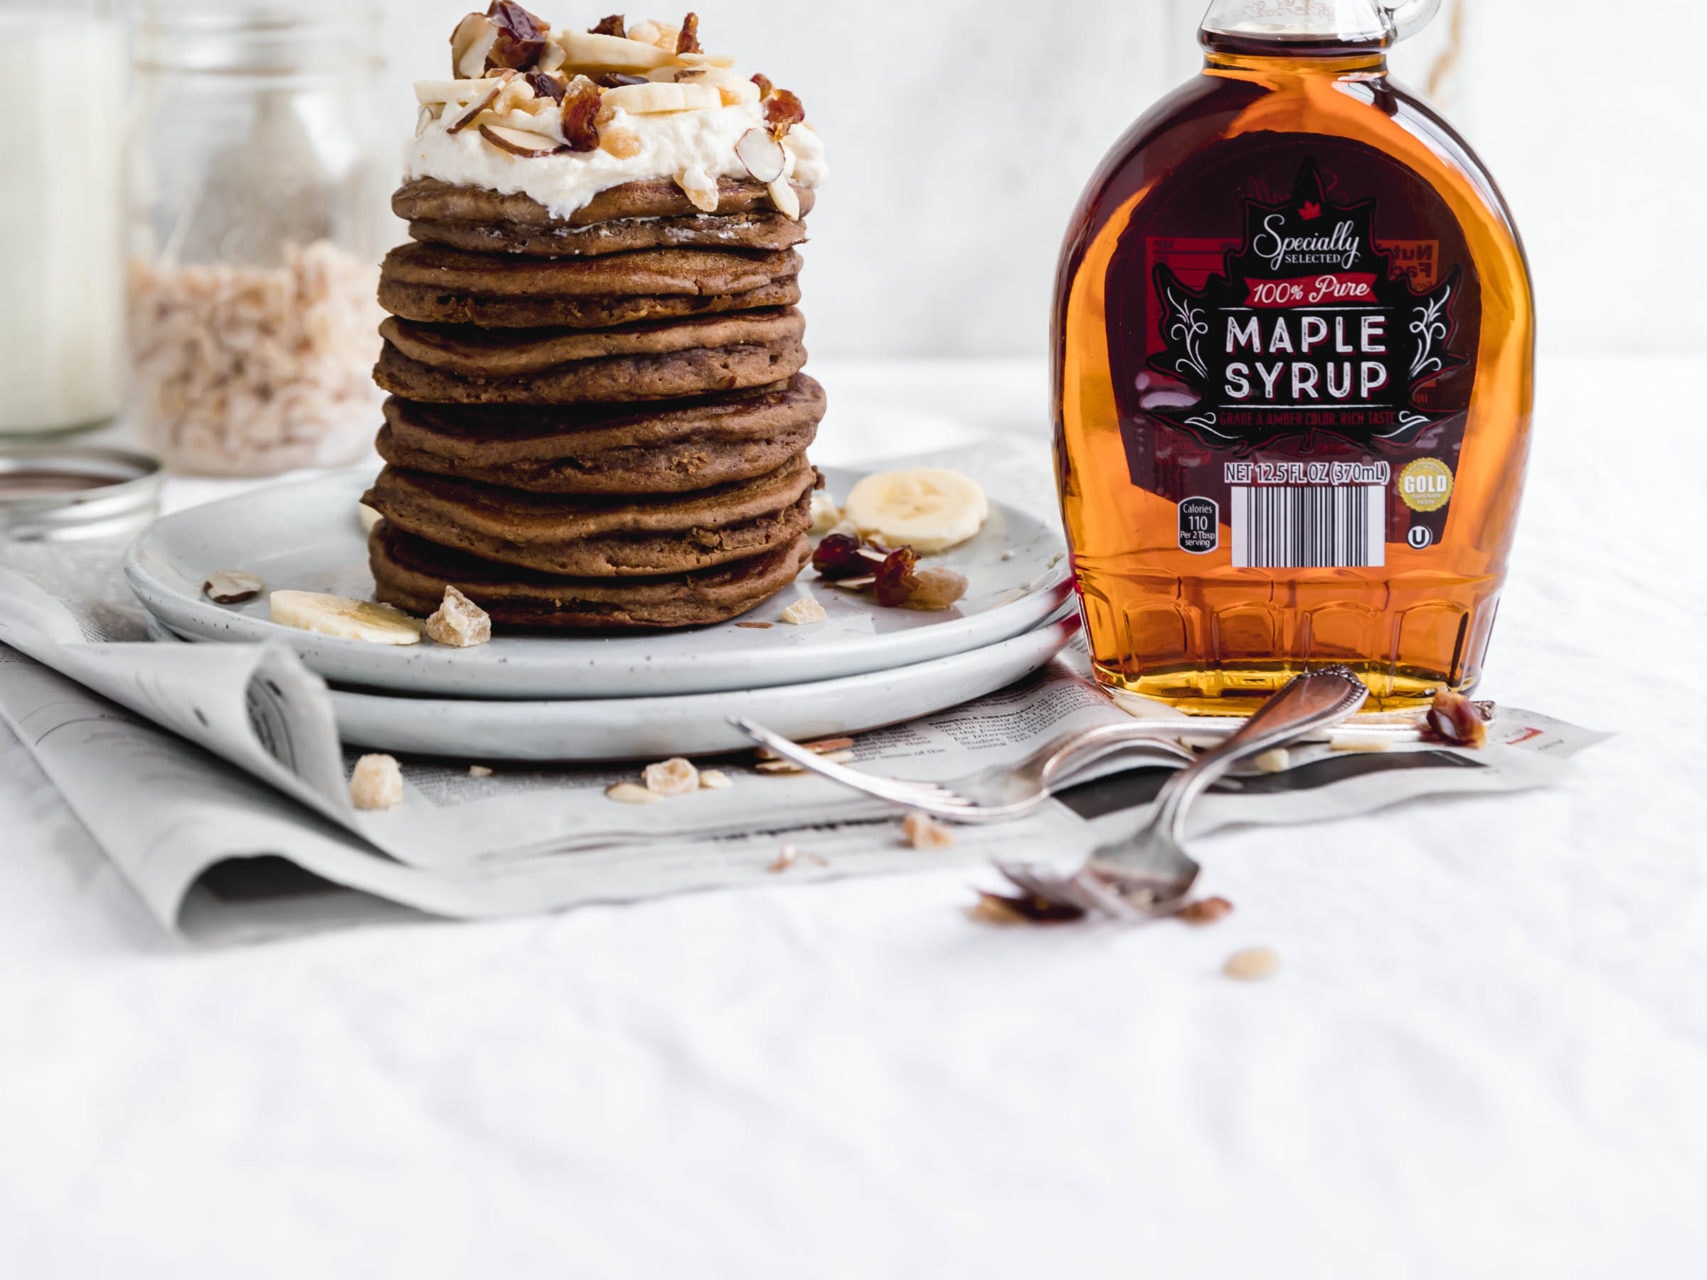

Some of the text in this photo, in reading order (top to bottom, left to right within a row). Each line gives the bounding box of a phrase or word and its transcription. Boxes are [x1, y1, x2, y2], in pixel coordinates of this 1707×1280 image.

[1253, 214, 1361, 270] Specially
[1284, 252, 1341, 264] SELECTED
[1253, 274, 1370, 304] 100% Pure
[1225, 315, 1388, 354] MAPLE
[1224, 361, 1388, 399] SYRUP
[1219, 412, 1252, 426] GRADE
[1266, 412, 1303, 426] AMBER
[1340, 411, 1365, 425] RICH
[1367, 410, 1396, 425] TASTE
[1225, 462, 1252, 483] NET
[1256, 462, 1287, 483] 12.5
[1289, 462, 1307, 483] FL
[1308, 462, 1329, 483] OZ
[1330, 461, 1390, 485] (370mL)
[1404, 475, 1448, 494] GOLD
[1182, 503, 1213, 514] Calories
[1188, 515, 1208, 531] 110
[1180, 530, 1192, 539] Per
[1198, 530, 1216, 541] Tbsp
[1185, 539, 1211, 548] serving
